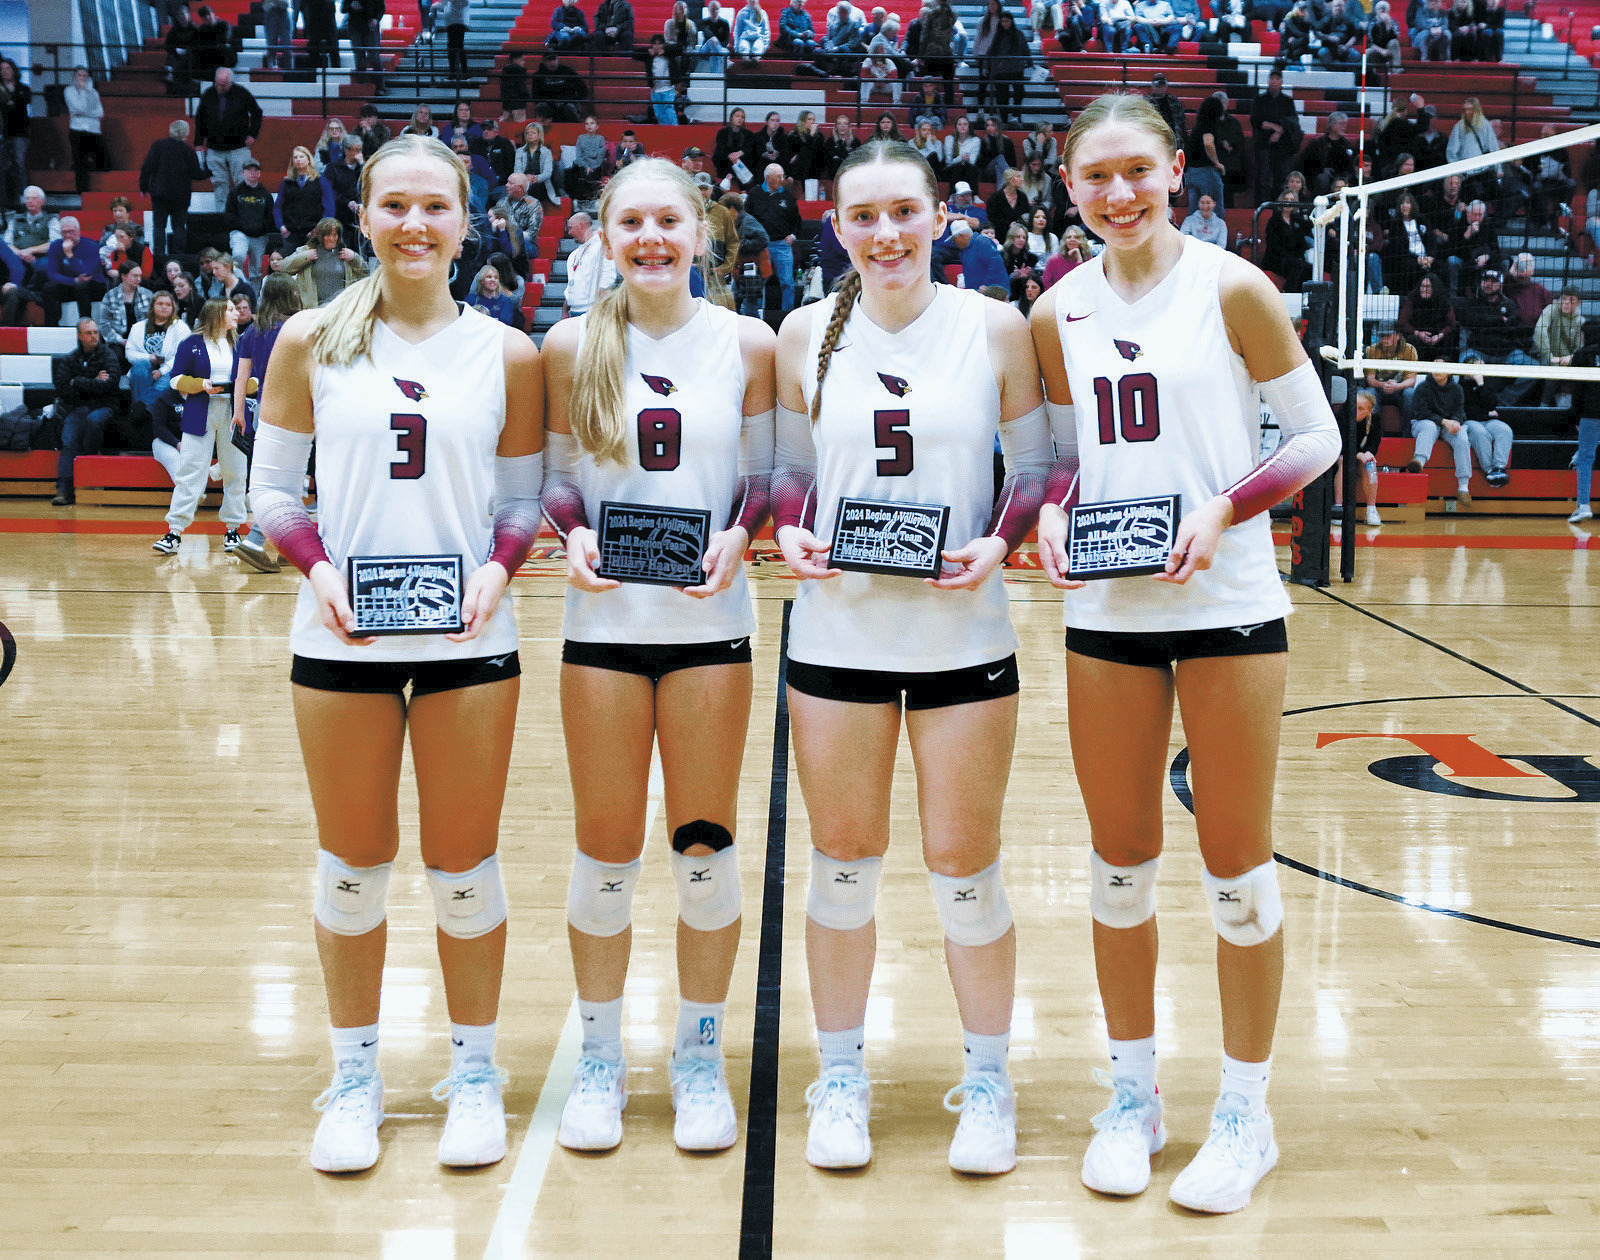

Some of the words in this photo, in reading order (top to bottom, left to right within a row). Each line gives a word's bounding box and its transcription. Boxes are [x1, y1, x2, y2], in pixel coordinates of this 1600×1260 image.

[1093, 372, 1161, 445] 10
[390, 413, 427, 479] 3
[637, 408, 681, 471] 8
[873, 408, 914, 477] 5
[608, 515, 627, 528] 2024
[628, 515, 655, 531] Region
[662, 517, 701, 535] Volleyball
[845, 509, 864, 521] 2024
[865, 508, 891, 523] Region
[899, 511, 938, 528] Volleyball
[1076, 512, 1095, 527] 2024
[1095, 509, 1122, 524] Region
[619, 534, 632, 546] All
[664, 538, 687, 551] Team
[853, 526, 866, 537] All
[868, 527, 897, 541] Region
[900, 530, 923, 542] Team
[841, 544, 890, 559] Meredith
[893, 549, 928, 562] Romfo
